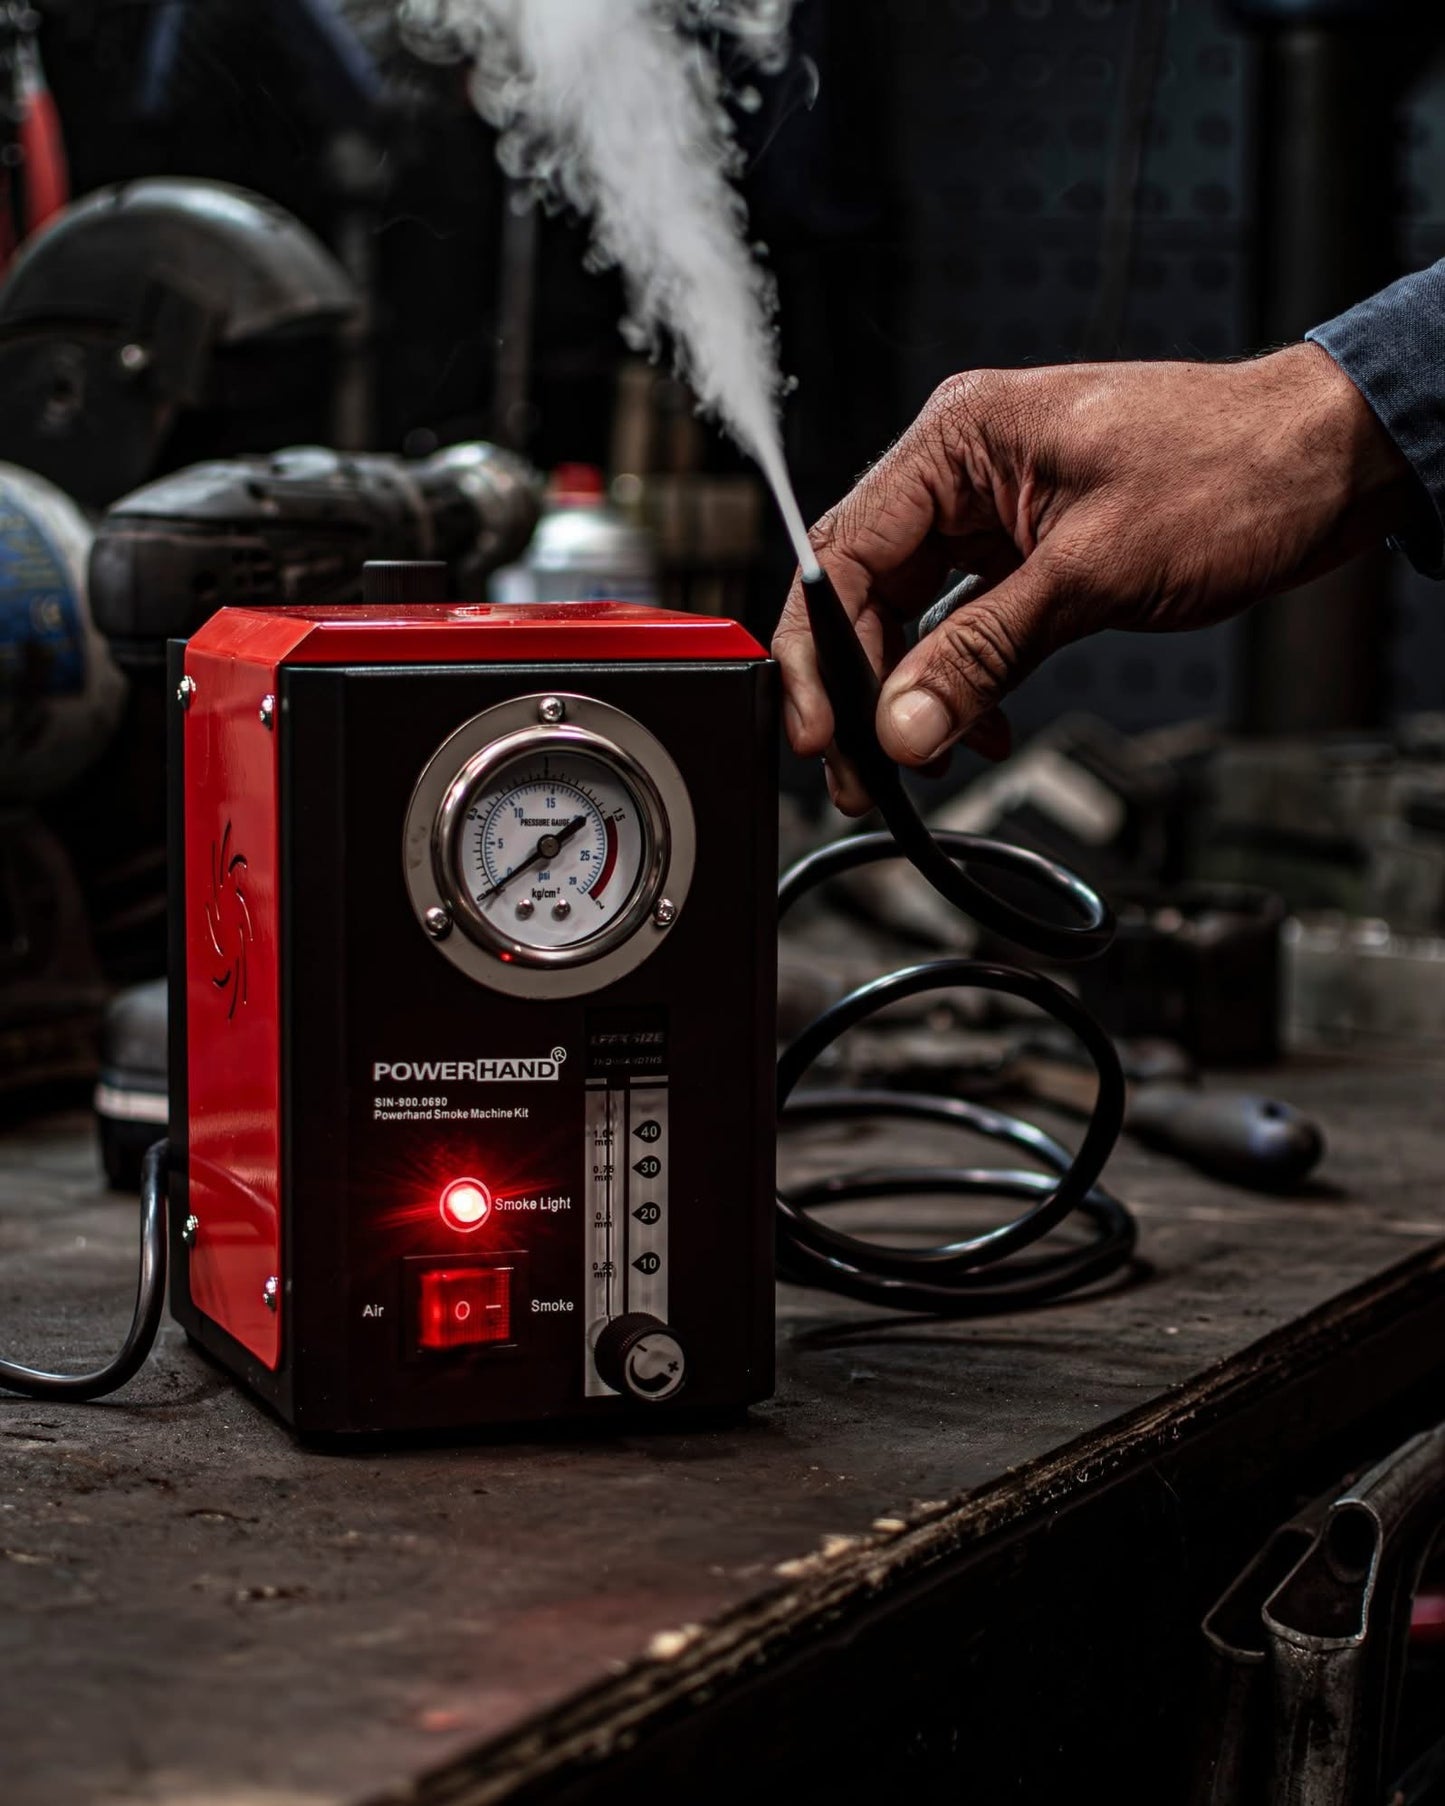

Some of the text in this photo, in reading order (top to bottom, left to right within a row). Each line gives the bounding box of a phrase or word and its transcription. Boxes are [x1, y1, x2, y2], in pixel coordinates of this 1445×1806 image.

[545, 797, 556, 809] 15
[514, 807, 524, 819] 10
[612, 807, 626, 823] 1.5
[520, 818, 551, 827] PRESSURE
[551, 818, 570, 827] GAUGE
[498, 838, 504, 849] 5
[580, 850, 591, 862] 25
[538, 871, 550, 883] psi
[595, 900, 605, 911] 2
[374, 1097, 448, 1108] SIN-900.0690
[374, 1107, 529, 1121] Powerhand Smoke Machine Kit
[641, 1125, 658, 1138] 40
[641, 1161, 658, 1173] 30
[494, 1197, 571, 1212] Smoke Light
[640, 1207, 657, 1220] 20
[640, 1257, 657, 1270] 10
[362, 1304, 384, 1317] Air
[531, 1299, 574, 1312] Smoke
